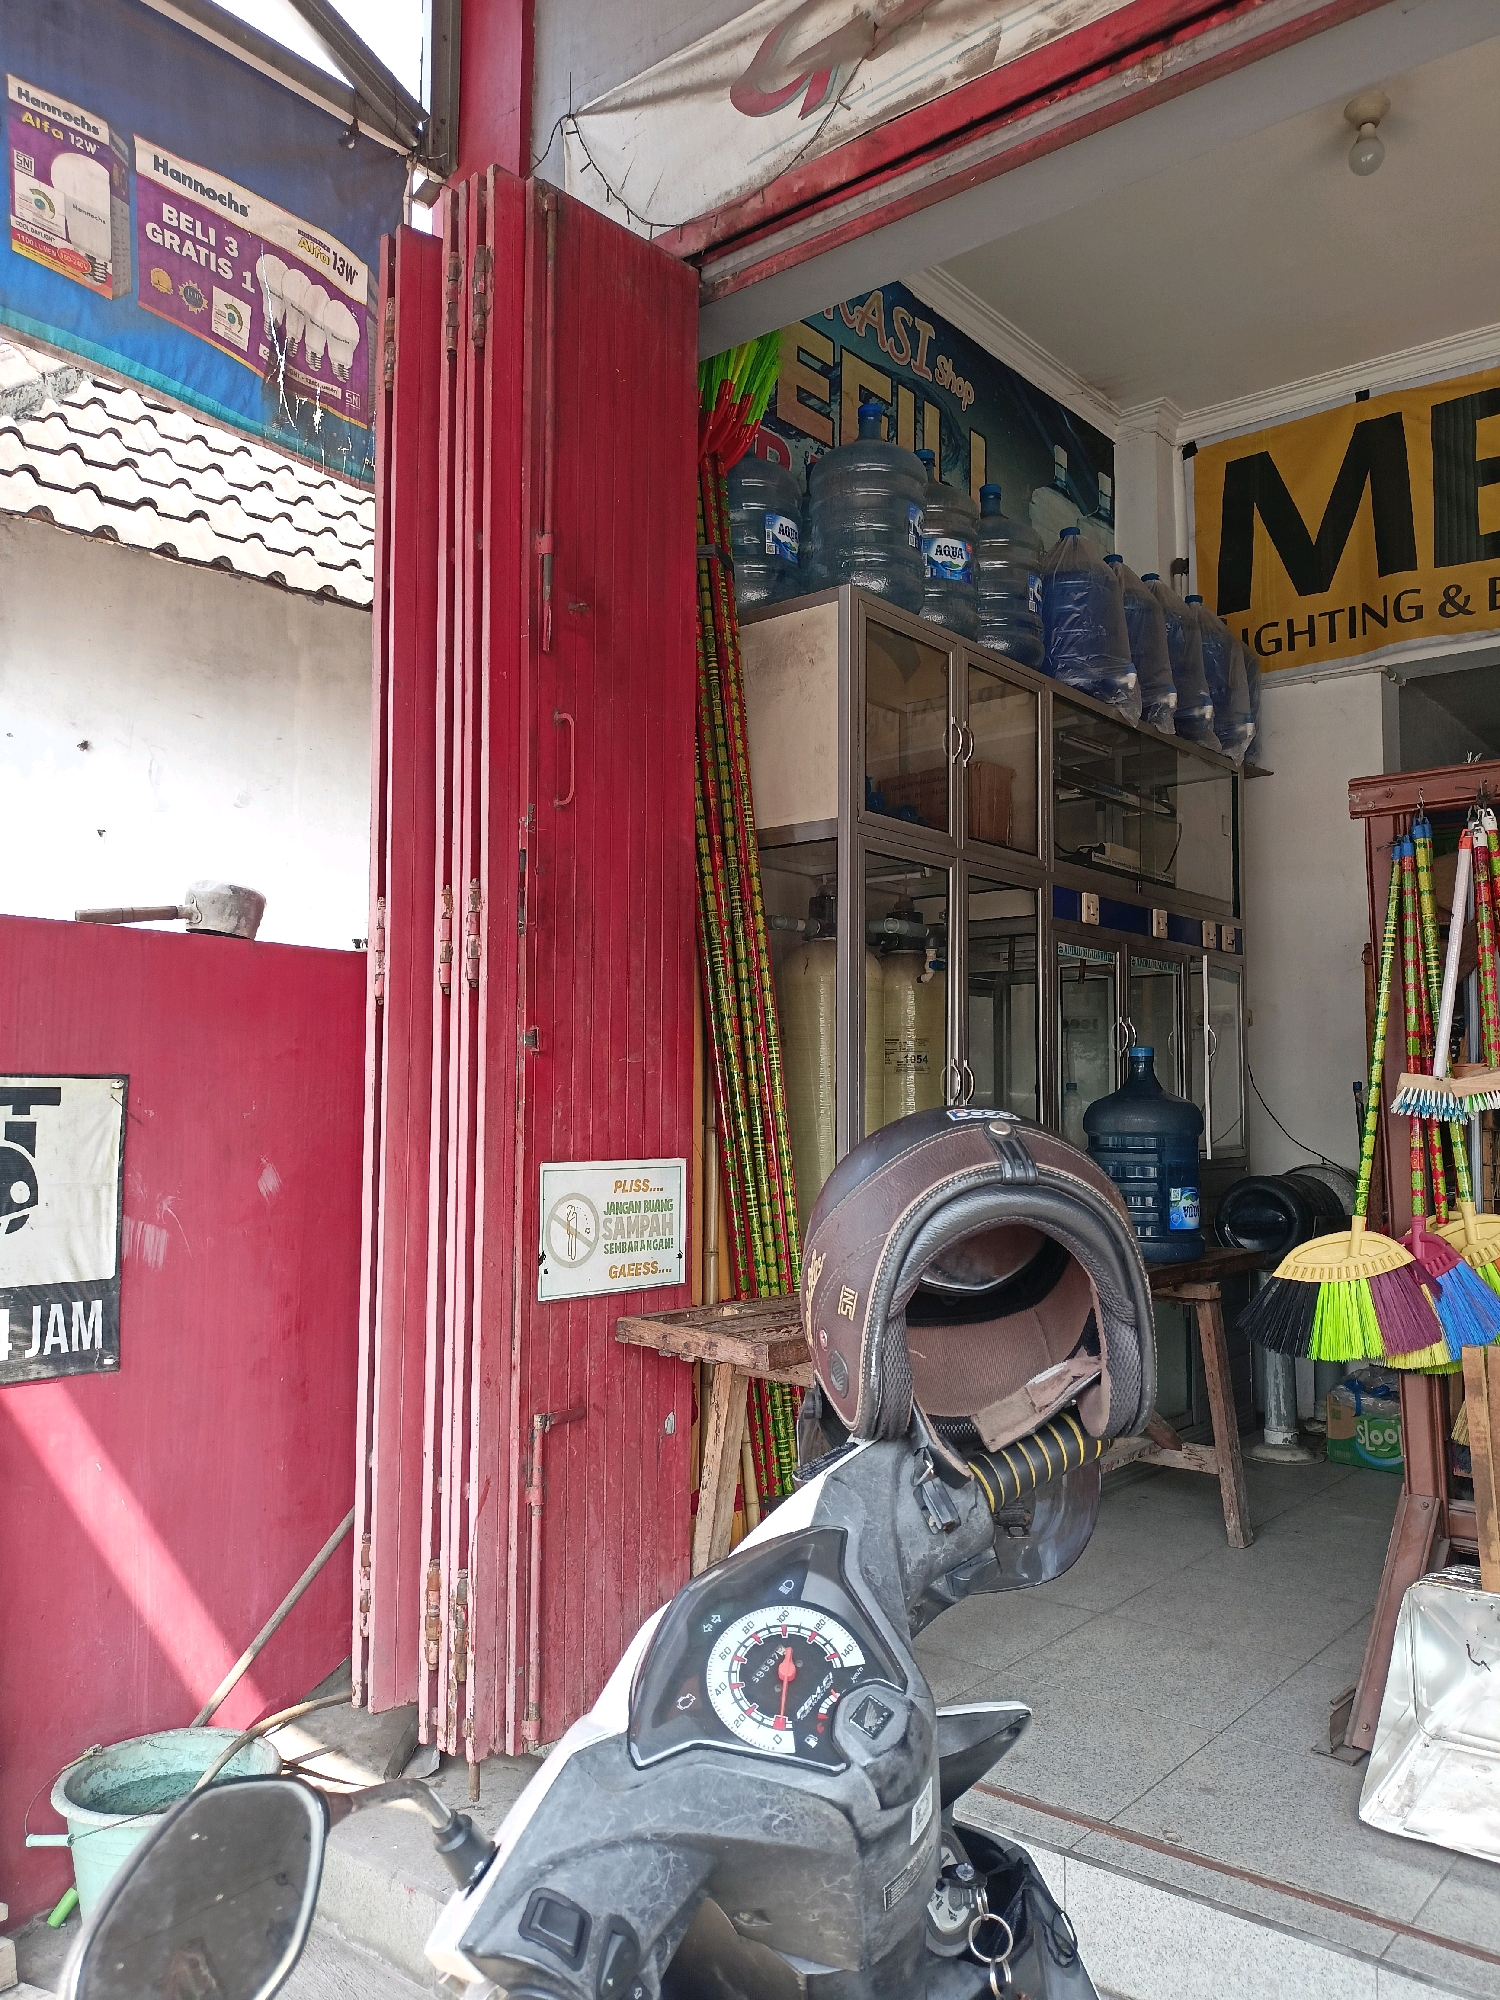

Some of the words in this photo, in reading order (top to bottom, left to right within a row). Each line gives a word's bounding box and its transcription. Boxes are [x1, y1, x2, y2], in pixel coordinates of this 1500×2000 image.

[17, 86, 100, 136] Hannochs
[22, 111, 64, 141] Alfa
[16, 154, 33, 171] SNI
[153, 154, 249, 218] Hannochs
[162, 202, 216, 247] BELI
[224, 236, 239, 258] 3
[145, 222, 233, 280] GRATIS
[241, 270, 255, 294] 1
[298, 237, 330, 266] Alfa
[332, 250, 357, 285] 13W
[934, 354, 975, 411] Shop
[934, 544, 965, 560] AQUA
[1221, 588, 1424, 656] IGHTING
[1438, 584, 1476, 618] &
[603, 1201, 642, 1216] JANGAN
[643, 1198, 674, 1214] BUANG
[602, 1213, 674, 1241] SAMPAH
[838, 1285, 858, 1320] SNI
[24, 1299, 103, 1359] JAM
[741, 1620, 755, 1635] 80
[776, 1609, 790, 1624] 100
[718, 1646, 732, 1661] 60
[841, 1645, 855, 1658] 140
[714, 1682, 728, 1697] 40
[733, 1713, 747, 1729] 20
[772, 1733, 783, 1745] 0
